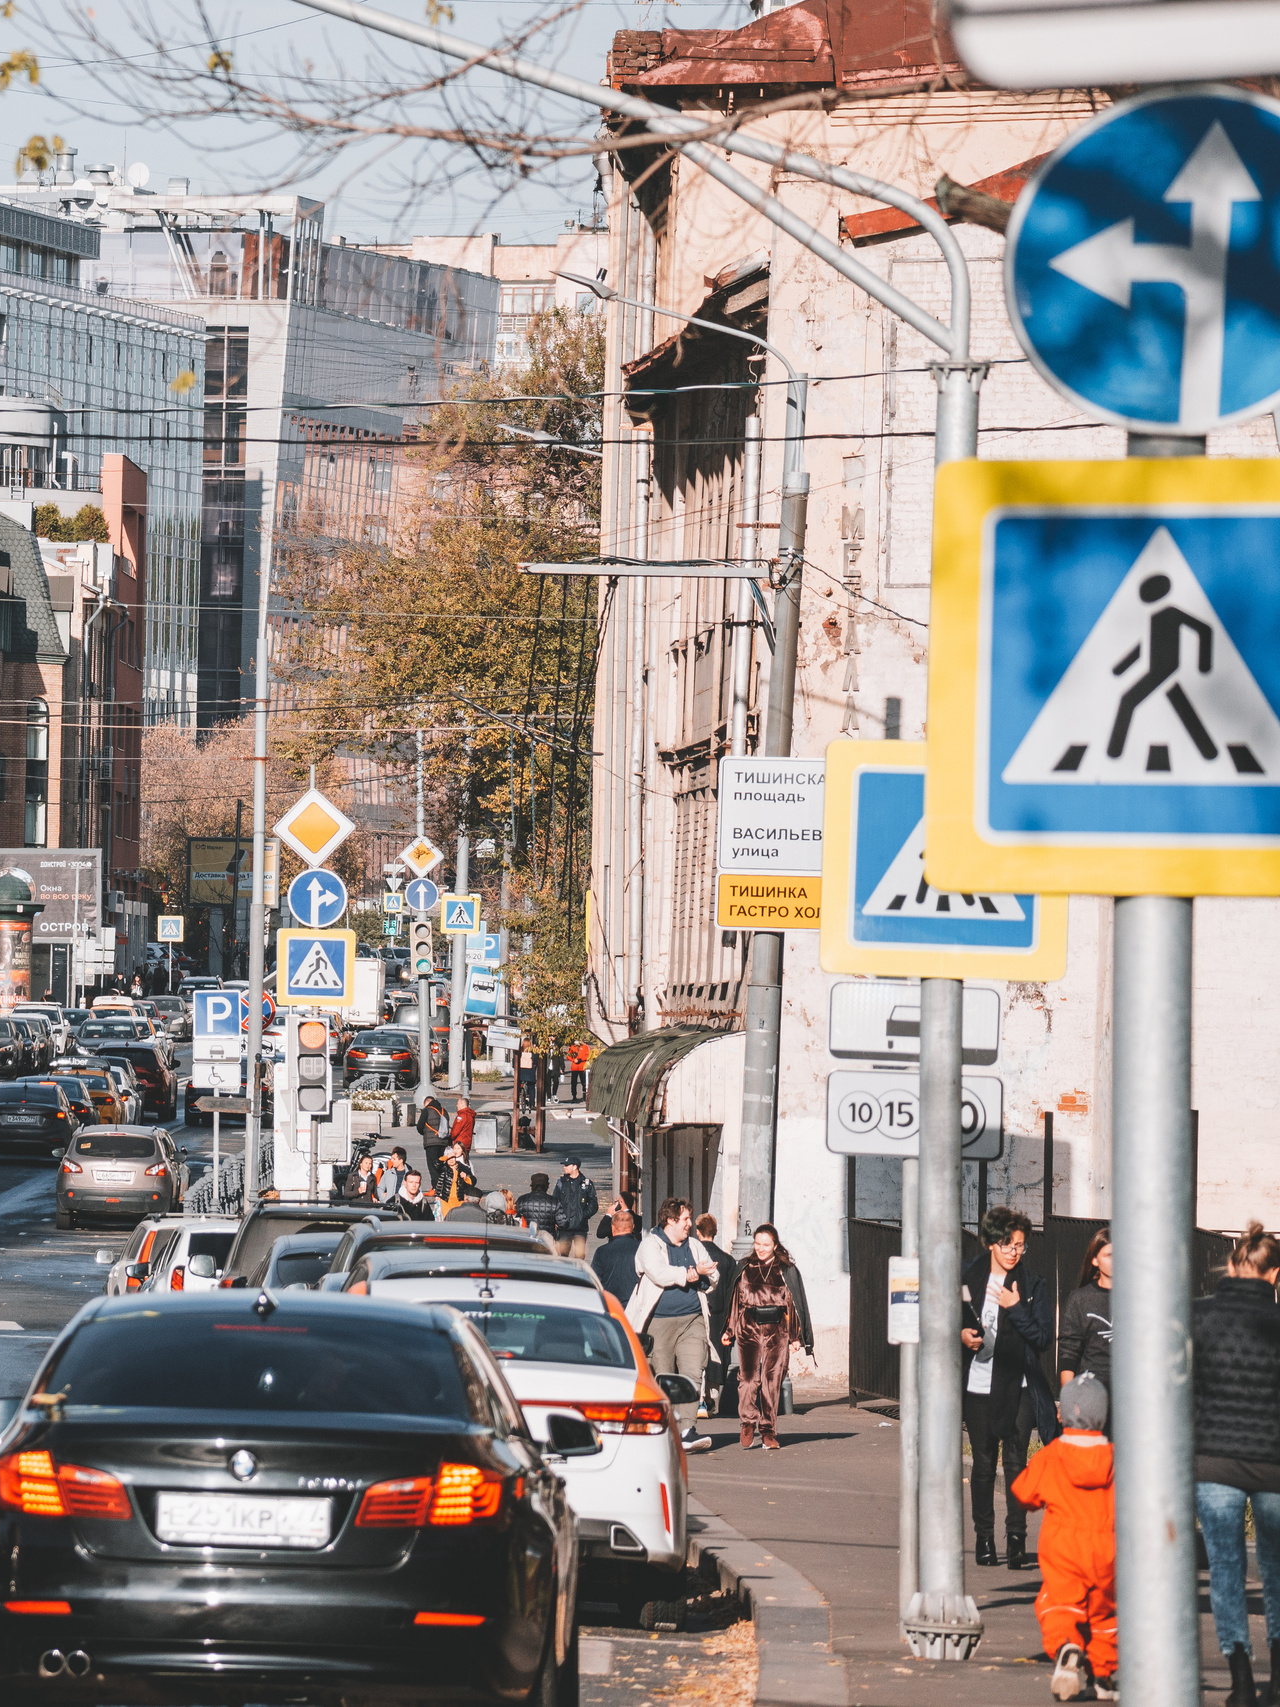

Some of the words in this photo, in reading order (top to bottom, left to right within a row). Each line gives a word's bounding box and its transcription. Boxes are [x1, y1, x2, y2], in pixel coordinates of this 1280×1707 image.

[733, 792, 806, 803] площадь
[732, 827, 823, 841] ВАСИЛЬЕВ
[731, 847, 779, 859] улица
[40, 884, 62, 892] Окна
[730, 885, 808, 899] ТИШИНКА
[729, 904, 789, 918] ГАСТРО
[206, 996, 232, 1033] P
[69, 1057, 89, 1065] Uber
[848, 1102, 873, 1123] 10
[884, 1101, 914, 1128] 15
[961, 1101, 979, 1134] 0
